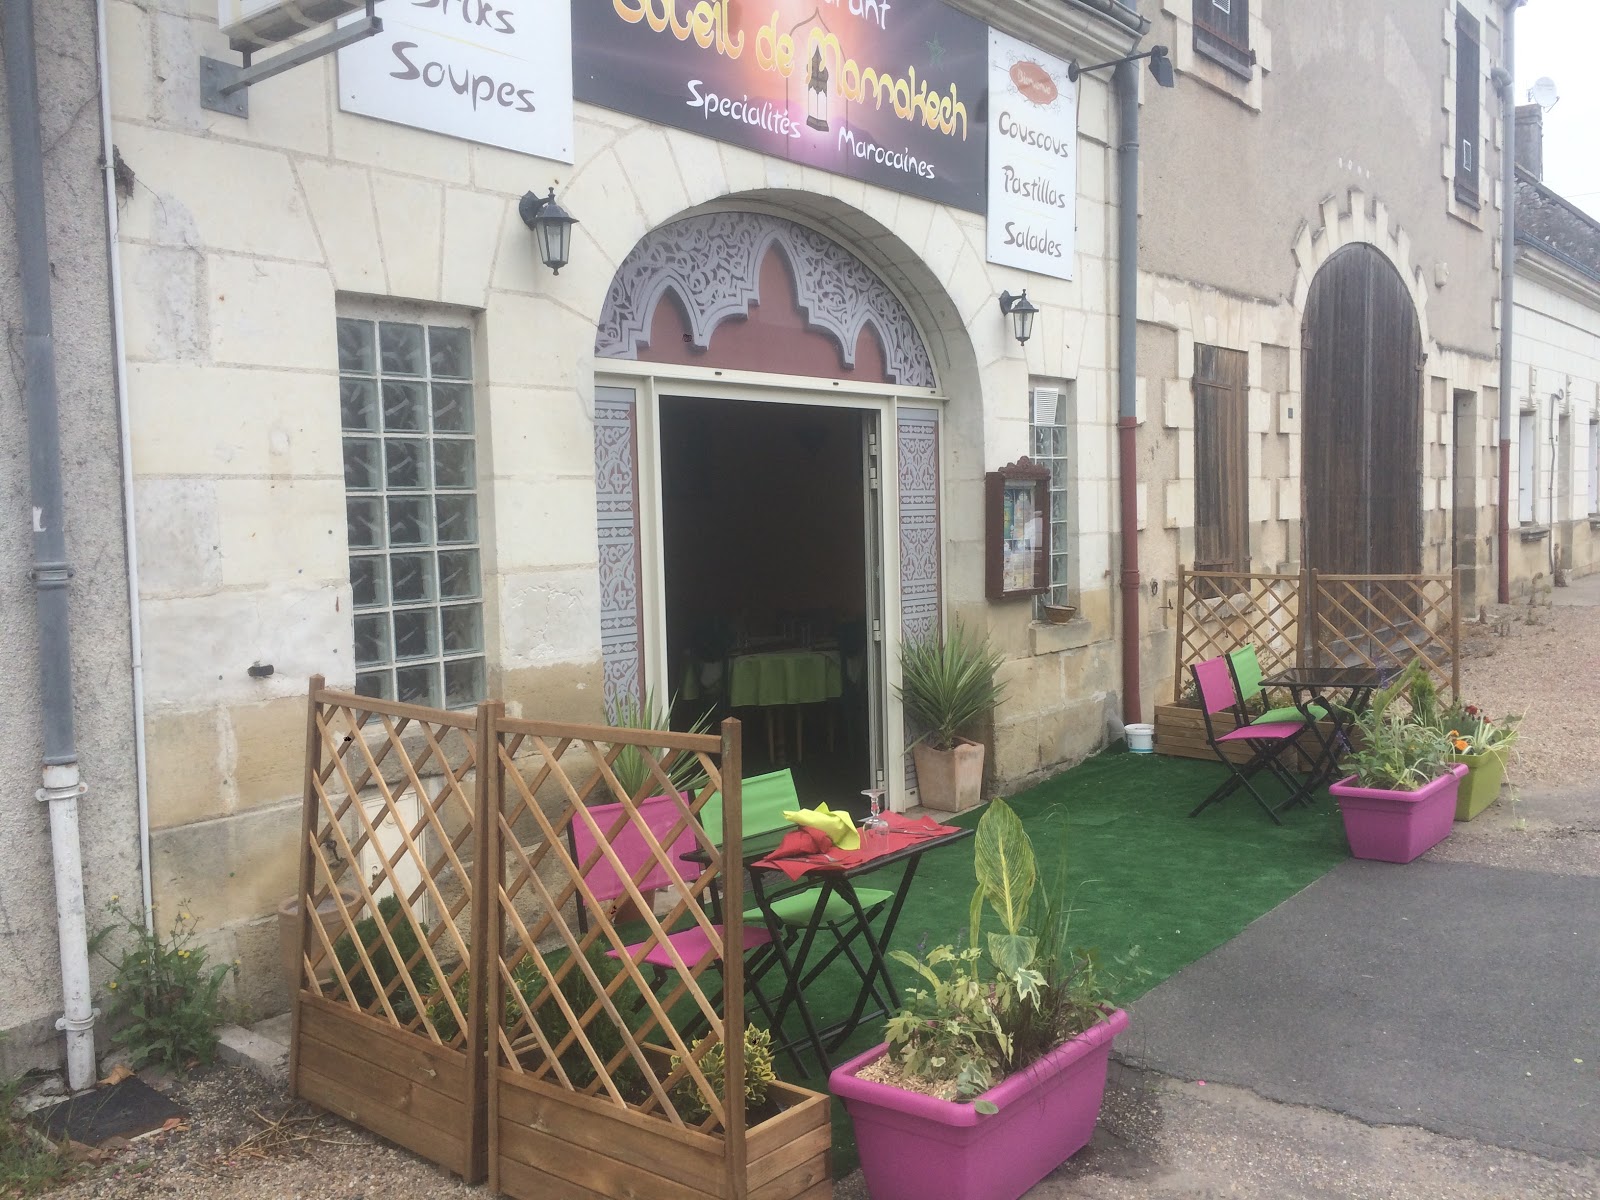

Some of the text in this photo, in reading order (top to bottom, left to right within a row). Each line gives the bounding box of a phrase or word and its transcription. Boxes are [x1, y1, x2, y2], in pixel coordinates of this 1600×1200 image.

[389, 40, 536, 113] Soupes
[755, 11, 795, 78] de
[805, 26, 968, 142] Marrakech
[686, 79, 935, 179] Specialités Marocaines
[998, 111, 1069, 158] Couscous
[1001, 165, 1066, 209] Pastillas
[1003, 221, 1062, 258] Salades
